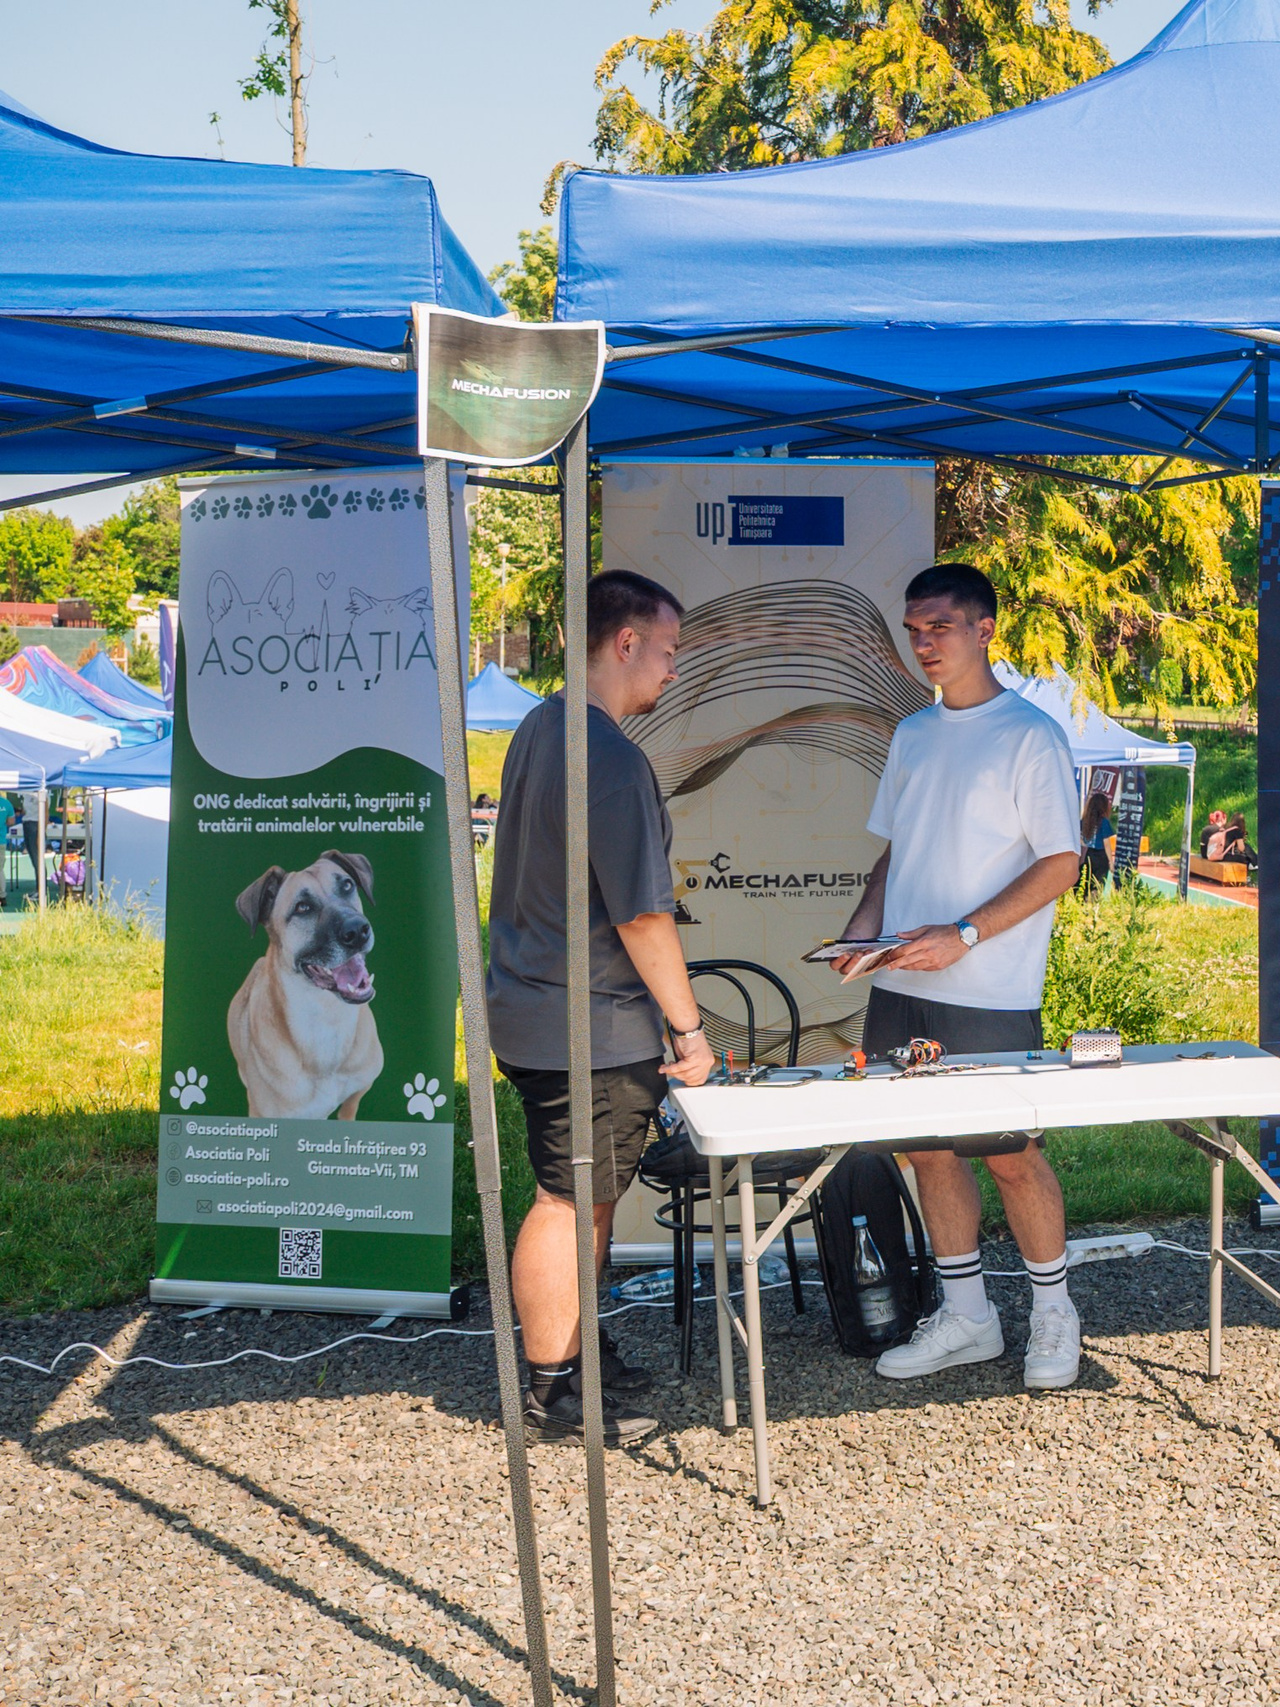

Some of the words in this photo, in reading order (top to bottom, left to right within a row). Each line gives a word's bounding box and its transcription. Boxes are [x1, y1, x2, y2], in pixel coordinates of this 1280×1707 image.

[451, 378, 571, 400] MECHAFUSION
[738, 502, 784, 514] Universitatea
[738, 514, 776, 527] Politehnica
[739, 526, 773, 540] Timișoara
[193, 793, 231, 810] ONG
[233, 793, 289, 810] dedicat
[291, 792, 352, 811] salvării,
[354, 792, 415, 814] îngrijirii
[418, 792, 432, 813] și
[198, 816, 252, 833] tratării
[255, 816, 336, 833] animalelor
[338, 815, 425, 833] vulnerabile
[742, 891, 777, 899] TRAIN
[781, 890, 805, 898] THE
[809, 889, 854, 898] FUTURE
[185, 1120, 279, 1141] @asociatiapoli
[185, 1145, 244, 1160] Asociatia
[246, 1147, 270, 1162] Poli
[297, 1138, 342, 1154] Strada
[343, 1136, 407, 1160] Înfrățirea
[409, 1142, 427, 1157] 93
[184, 1170, 290, 1189] asociatia-poli.ro
[307, 1160, 397, 1180] Giarmata-Vii,
[399, 1163, 420, 1178] TM
[216, 1200, 414, 1222] asociatiapoli2024@gmail.com
